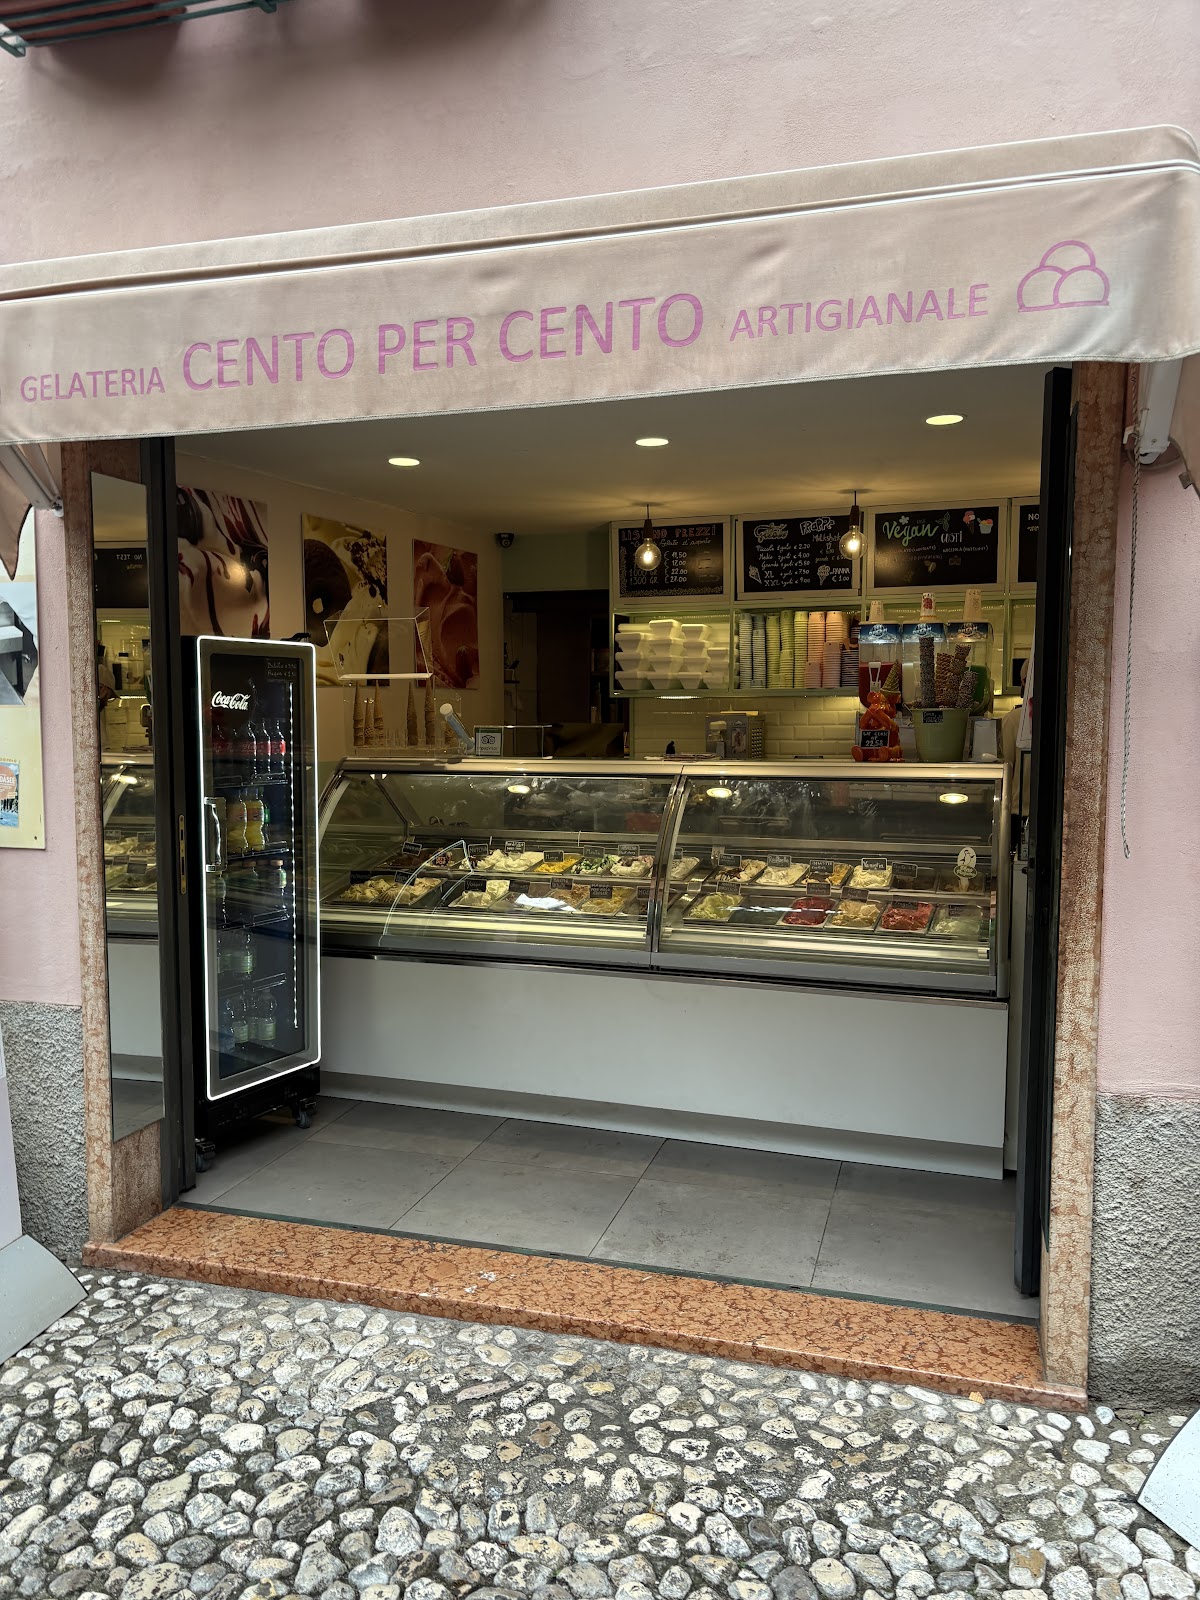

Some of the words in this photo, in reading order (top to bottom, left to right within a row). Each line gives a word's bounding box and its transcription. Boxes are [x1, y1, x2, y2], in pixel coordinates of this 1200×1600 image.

[20, 366, 165, 403] GELATERIA
[182, 328, 355, 391] CENTO
[377, 316, 477, 374] PER
[500, 293, 703, 362] CENTO
[729, 283, 990, 342] ARTIGIANALE
[882, 519, 939, 547] Vegan
[211, 691, 251, 711] Coca-Cola
